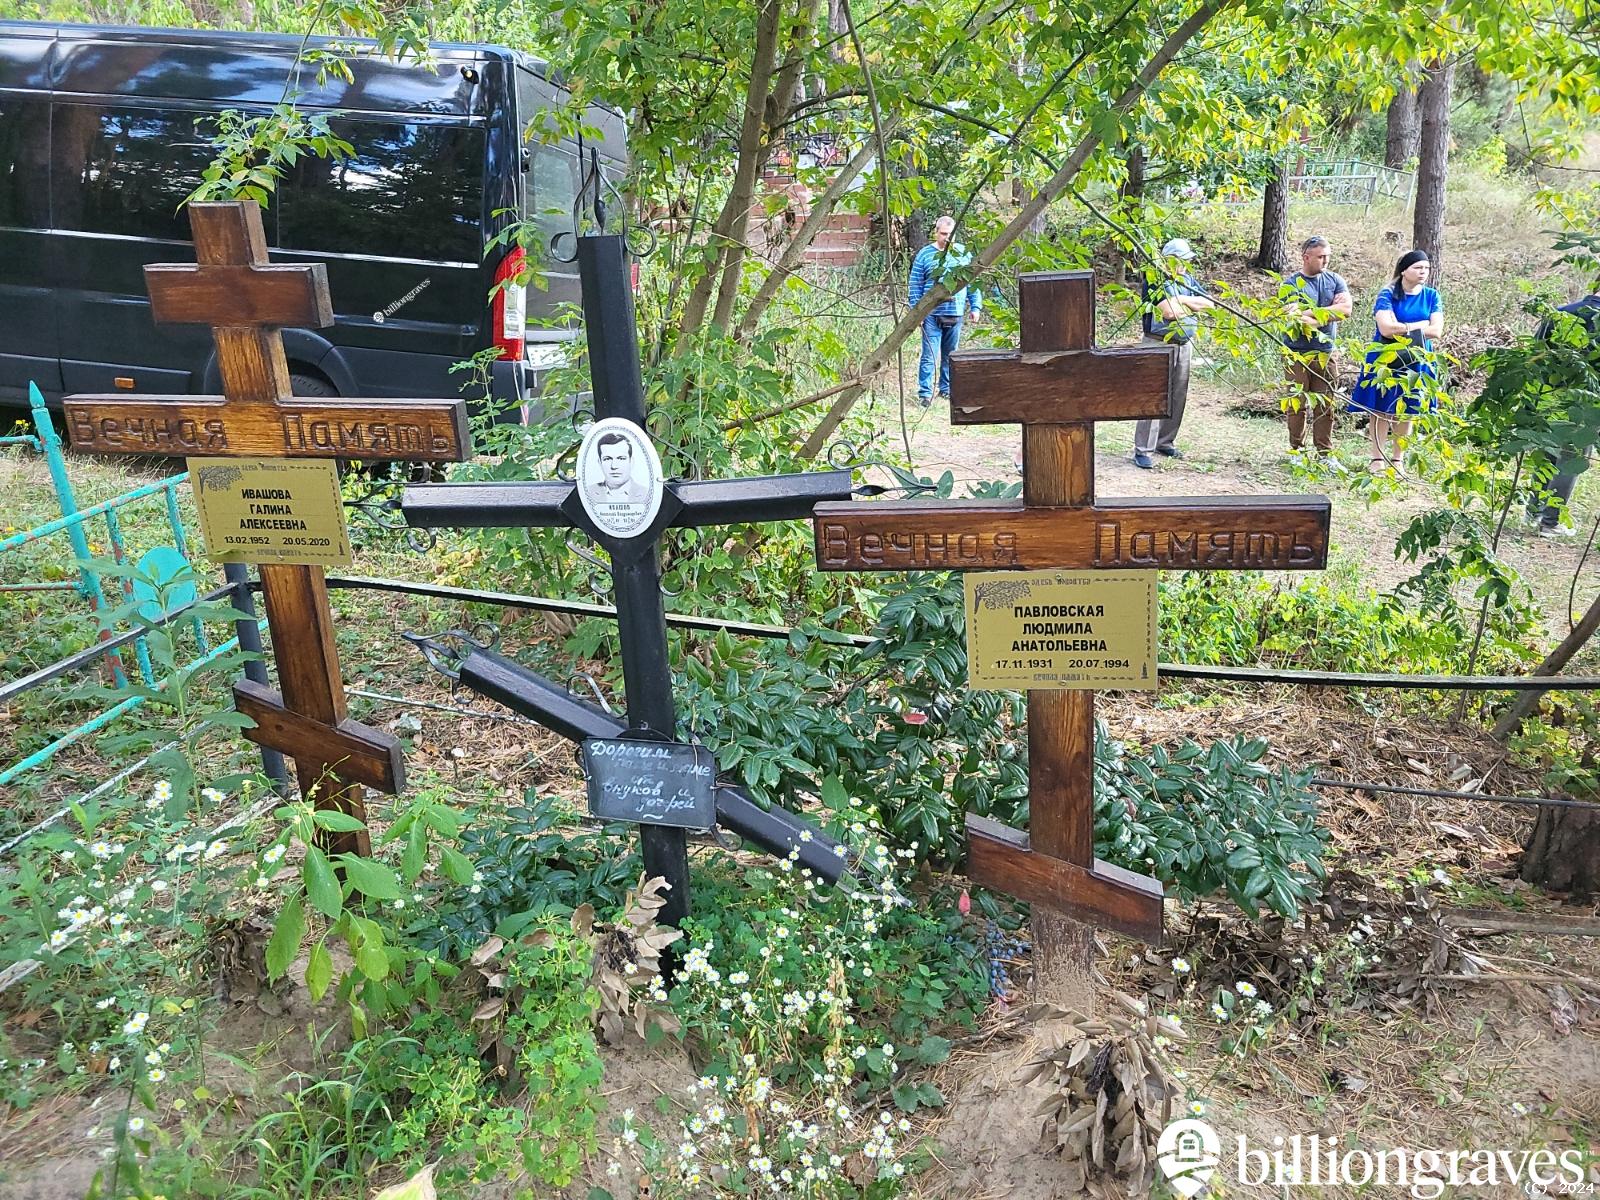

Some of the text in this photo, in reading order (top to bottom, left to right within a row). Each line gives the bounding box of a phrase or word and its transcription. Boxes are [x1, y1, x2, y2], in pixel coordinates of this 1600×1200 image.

[281, 411, 451, 452] Память
[241, 488, 292, 500] ИВАШОВА
[249, 504, 292, 515] ГАЛИНА
[239, 518, 307, 531] АЛЕКСЕЕВНА
[224, 536, 330, 546] 13.02.1952 20.05.2020
[823, 521, 1316, 566] Вечная Память
[1014, 605, 1104, 618] ПАВЛОВСКАЯ
[1022, 622, 1093, 636] ЛЮДМИЛА
[1011, 640, 1108, 652] АНАТОЛЬЕВНА
[995, 659, 1130, 669] 17.11.1931 20.07.1994
